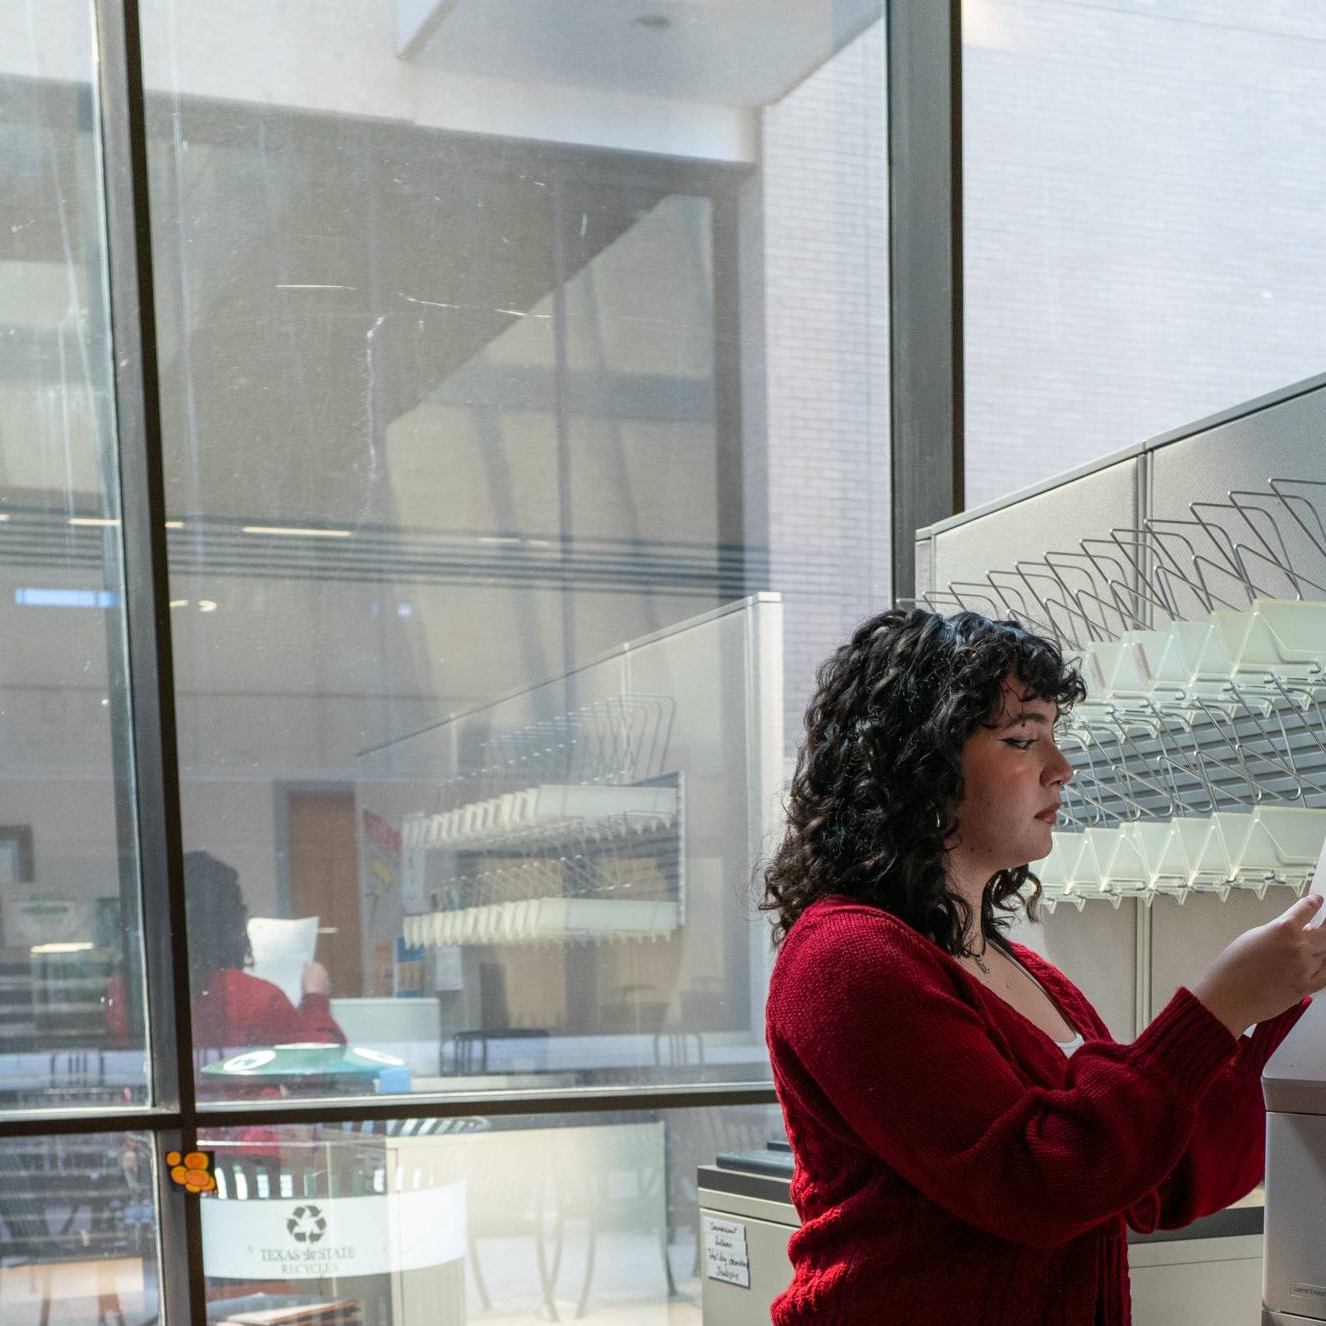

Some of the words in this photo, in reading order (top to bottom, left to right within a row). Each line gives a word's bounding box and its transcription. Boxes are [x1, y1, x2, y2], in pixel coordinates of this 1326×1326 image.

[260, 1248, 301, 1262] TEXAS
[318, 1246, 356, 1261] STATE
[280, 1262, 339, 1275] RECYCLES
